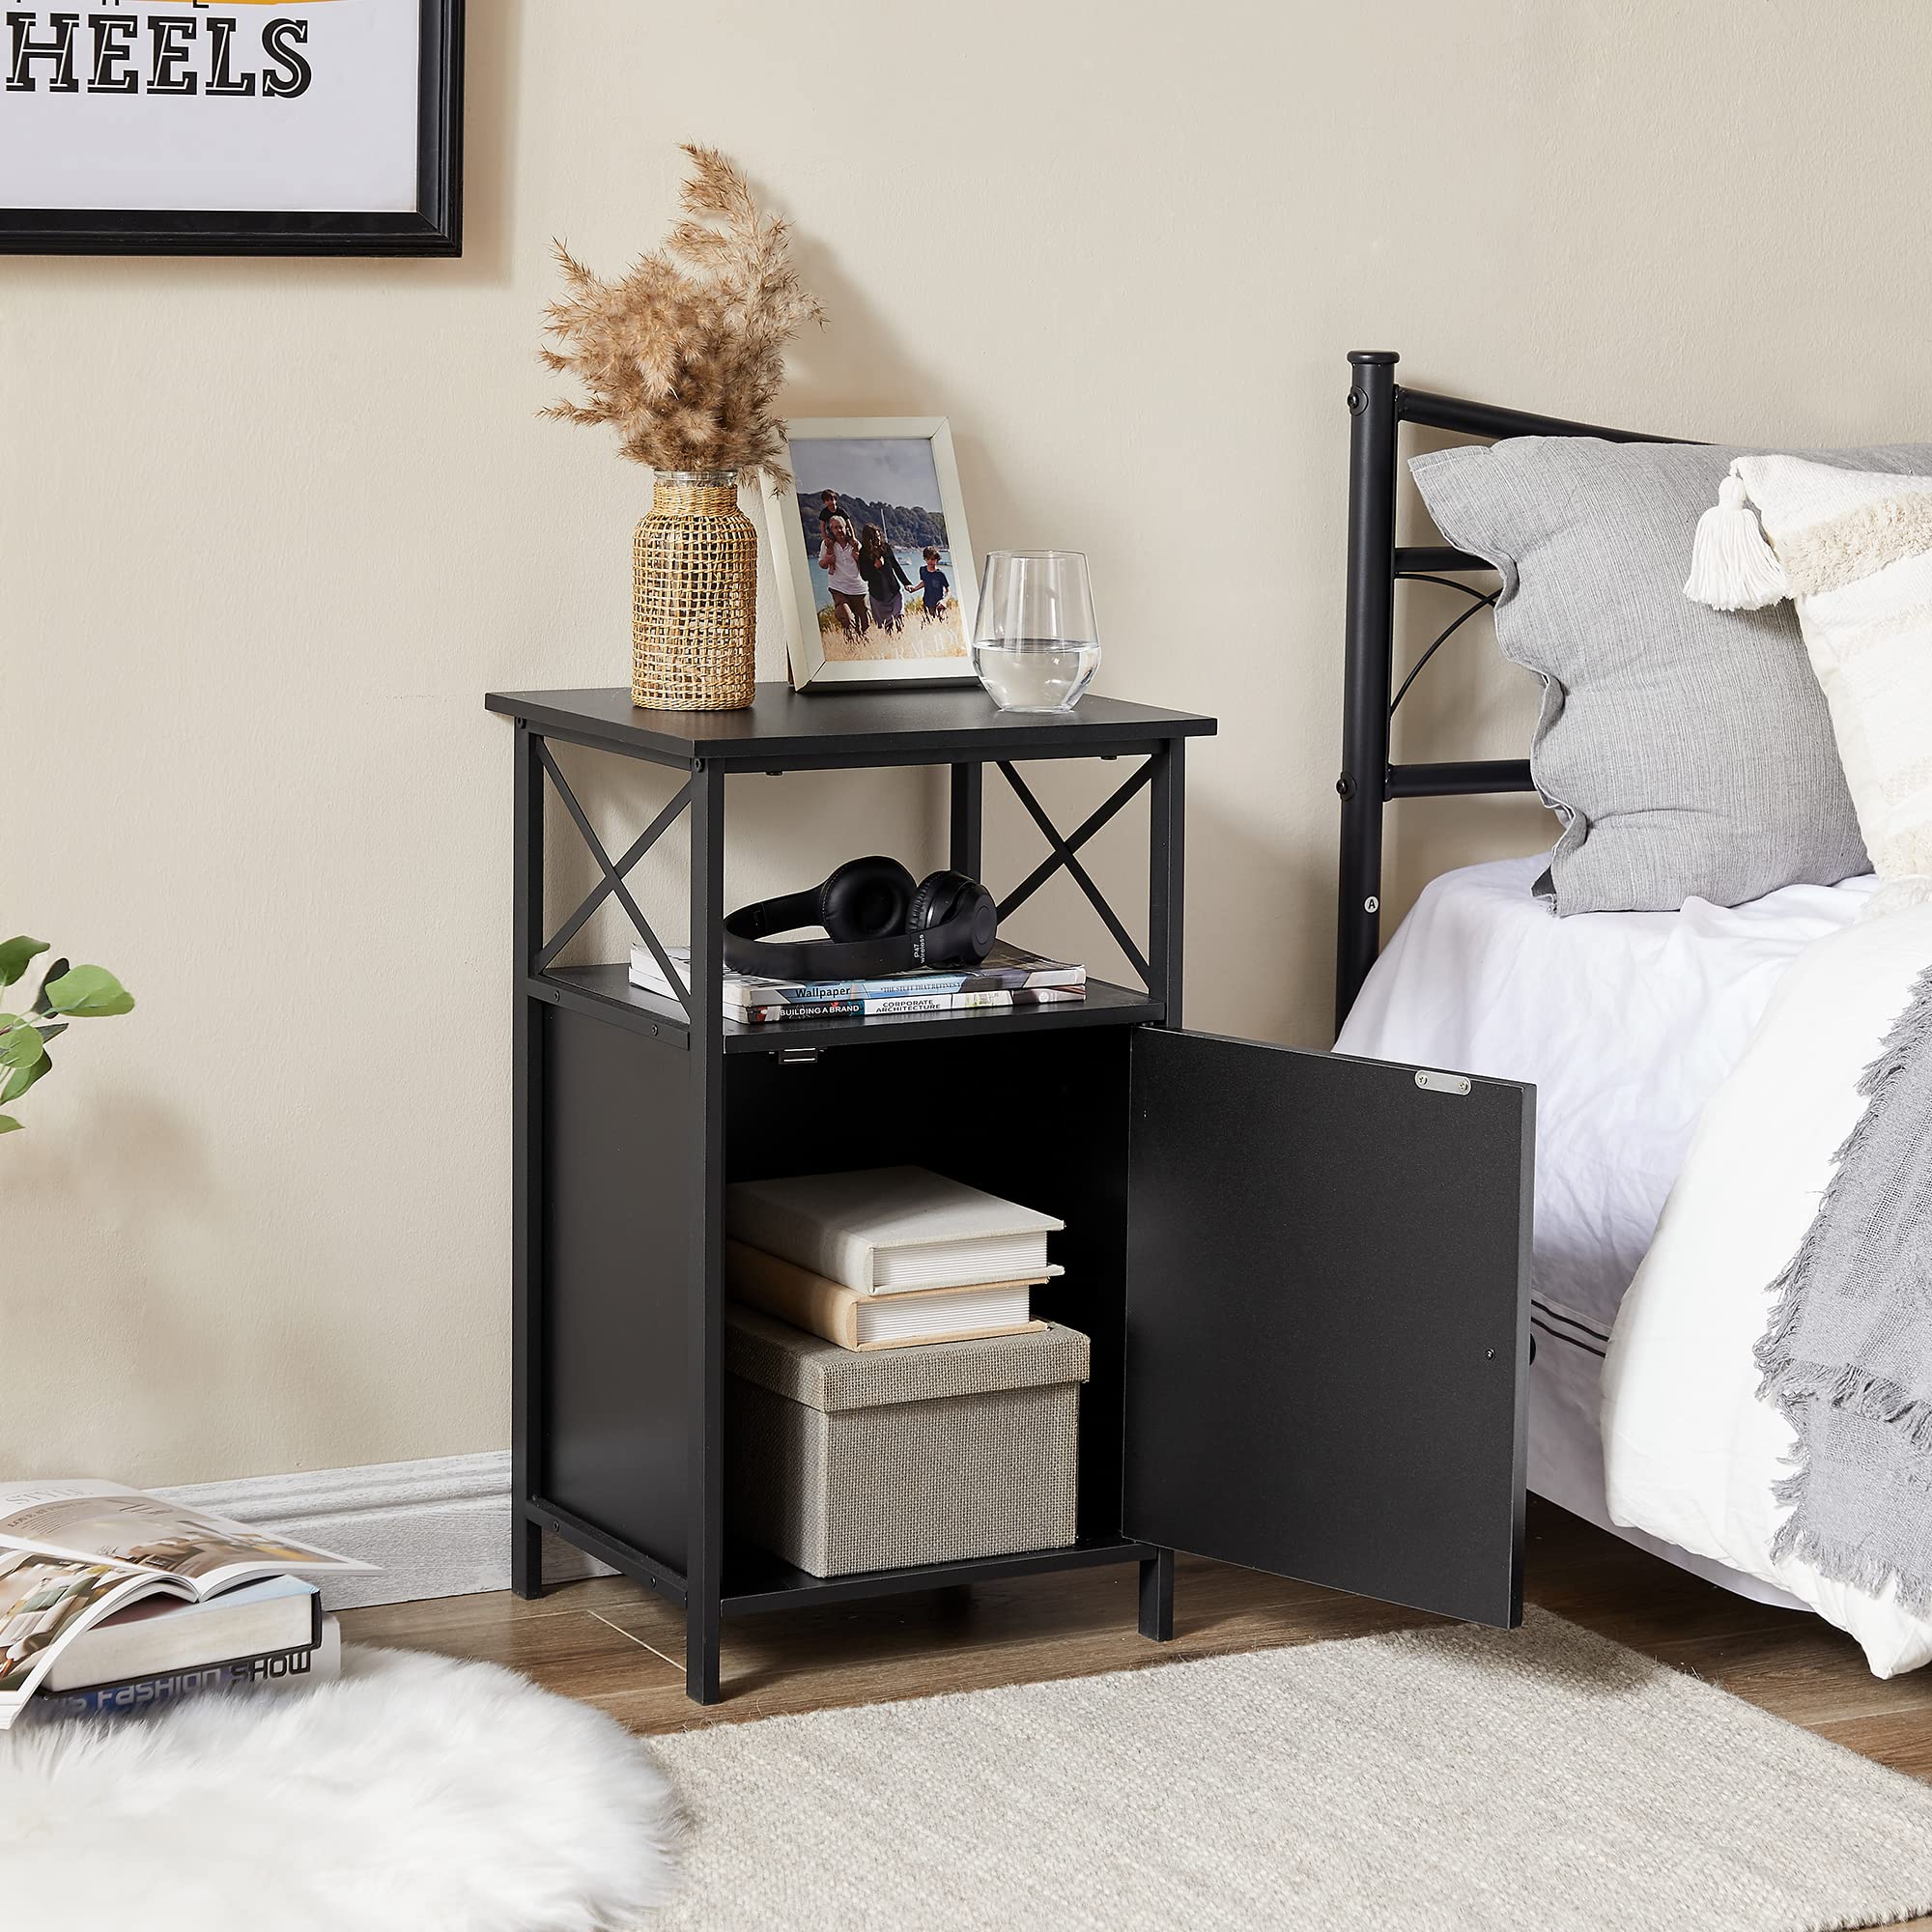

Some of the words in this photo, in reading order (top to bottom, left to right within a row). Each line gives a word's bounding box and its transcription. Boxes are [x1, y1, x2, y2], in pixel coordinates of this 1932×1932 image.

[6, 12, 313, 99] HEELS
[795, 987, 851, 1000] Wallpaper
[875, 1004, 941, 1013] ARCHITECTURE
[882, 999, 934, 1008] CORPORATE
[780, 1007, 821, 1016] BUILDING
[829, 1005, 860, 1013] BRAND
[230, 1650, 311, 1682] SHOW
